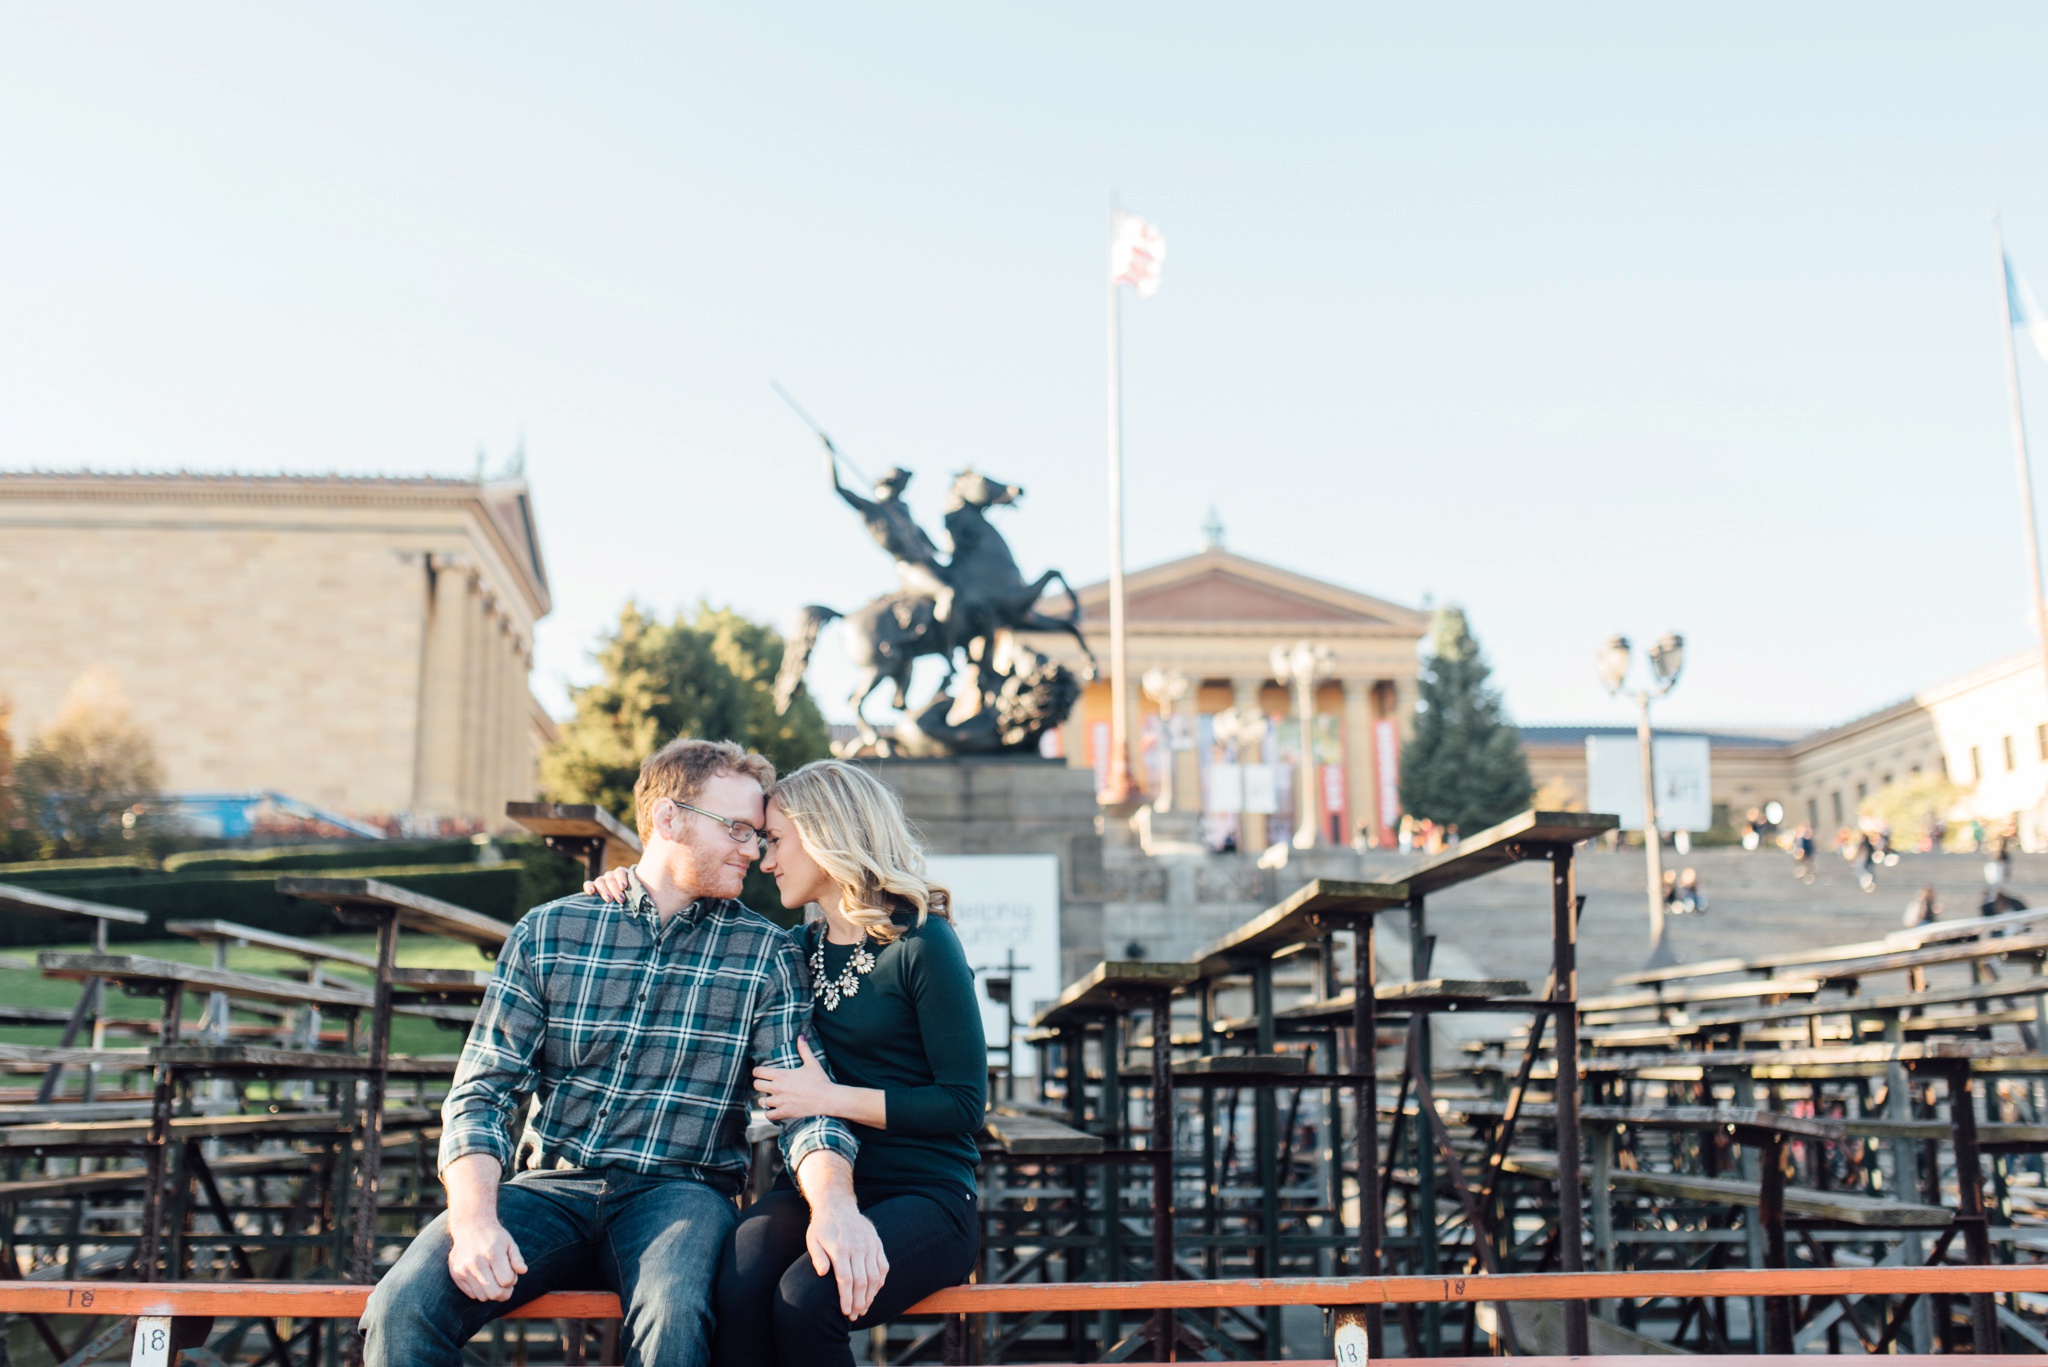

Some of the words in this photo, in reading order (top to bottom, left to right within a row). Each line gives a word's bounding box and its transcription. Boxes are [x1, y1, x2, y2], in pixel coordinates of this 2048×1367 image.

[66, 1289, 95, 1308] 18
[1443, 1279, 1466, 1300] 18
[141, 1329, 165, 1355] 18
[1338, 1343, 1358, 1363] 18
